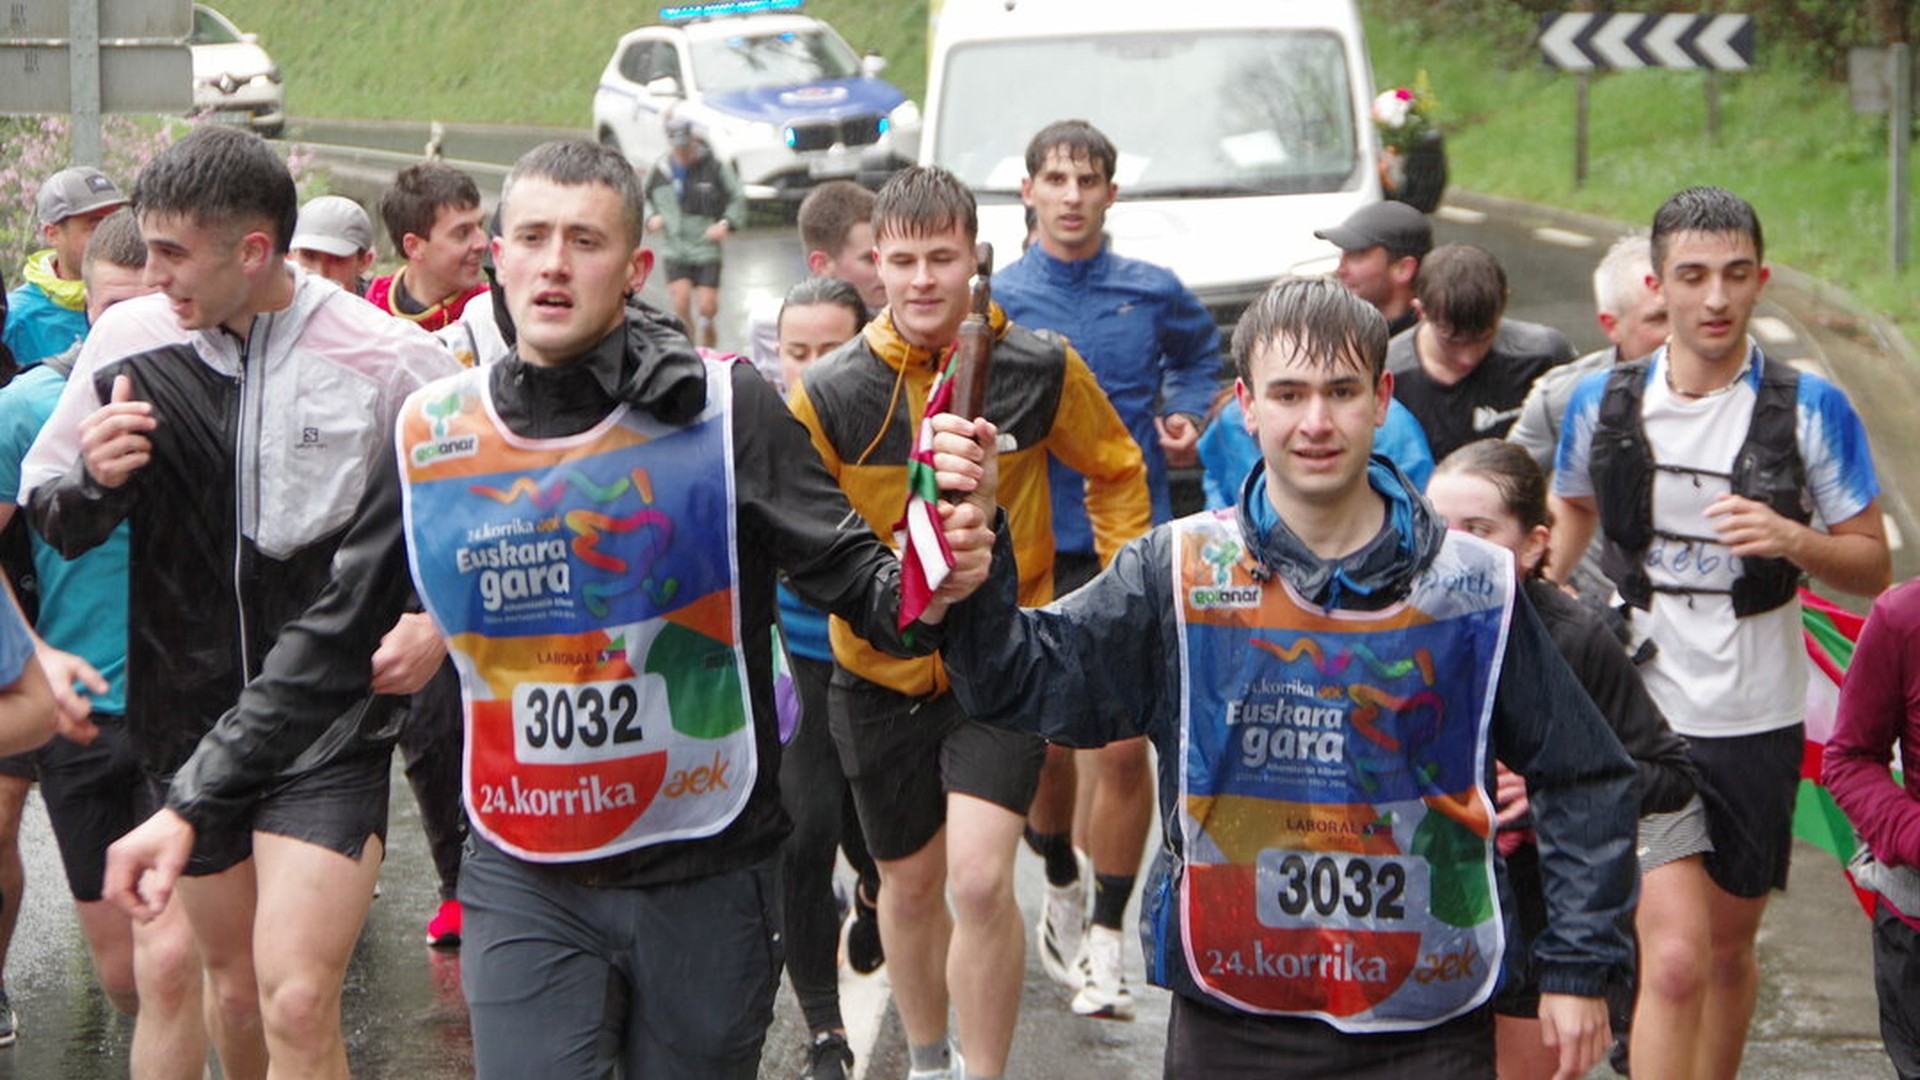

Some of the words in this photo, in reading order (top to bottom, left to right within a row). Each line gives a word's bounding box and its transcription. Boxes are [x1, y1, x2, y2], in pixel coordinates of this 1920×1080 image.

[457, 539, 567, 574] Euskara
[480, 561, 570, 612] gara
[538, 652, 592, 665] LABORAL
[525, 684, 643, 750] 3032
[1226, 698, 1344, 729] Euskara
[1241, 726, 1345, 768] gara
[480, 774, 637, 816] 24.korrika
[663, 750, 731, 798] aek
[1286, 818, 1358, 834] LABORAL
[1277, 854, 1406, 920] 3032
[1206, 939, 1387, 983] 24.korrika
[1414, 940, 1477, 984] aek
